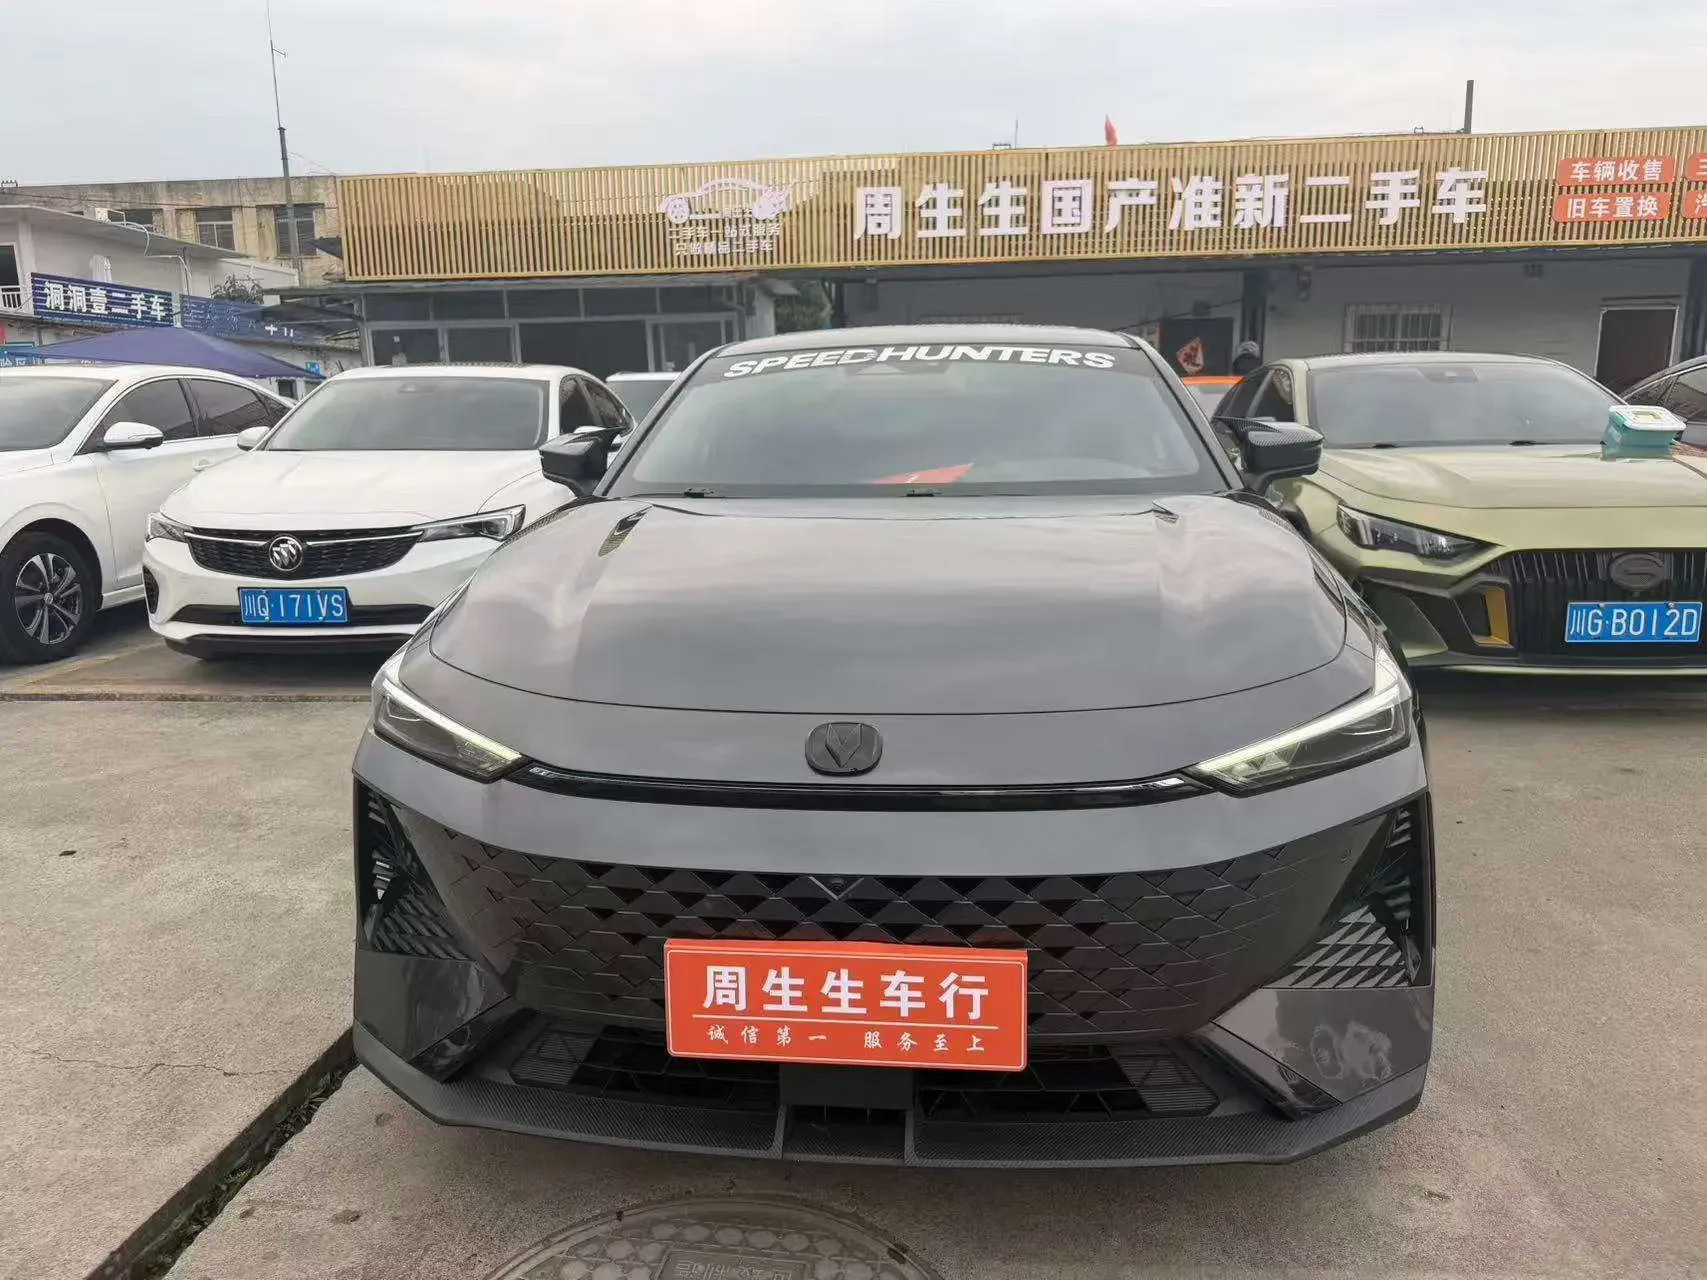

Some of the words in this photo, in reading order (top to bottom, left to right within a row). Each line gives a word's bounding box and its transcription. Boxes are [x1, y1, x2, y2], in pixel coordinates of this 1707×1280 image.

[1570, 159, 1662, 183] 车辆收售
[853, 167, 1487, 240] 周生生国产准新二手车
[1567, 195, 1659, 219] 旧车置换
[723, 345, 1116, 379] SPEEDHUNTERS
[703, 964, 989, 1020] 周生生车行
[707, 1023, 828, 1048] 诚信第一
[864, 1030, 985, 1052] 服务至上
